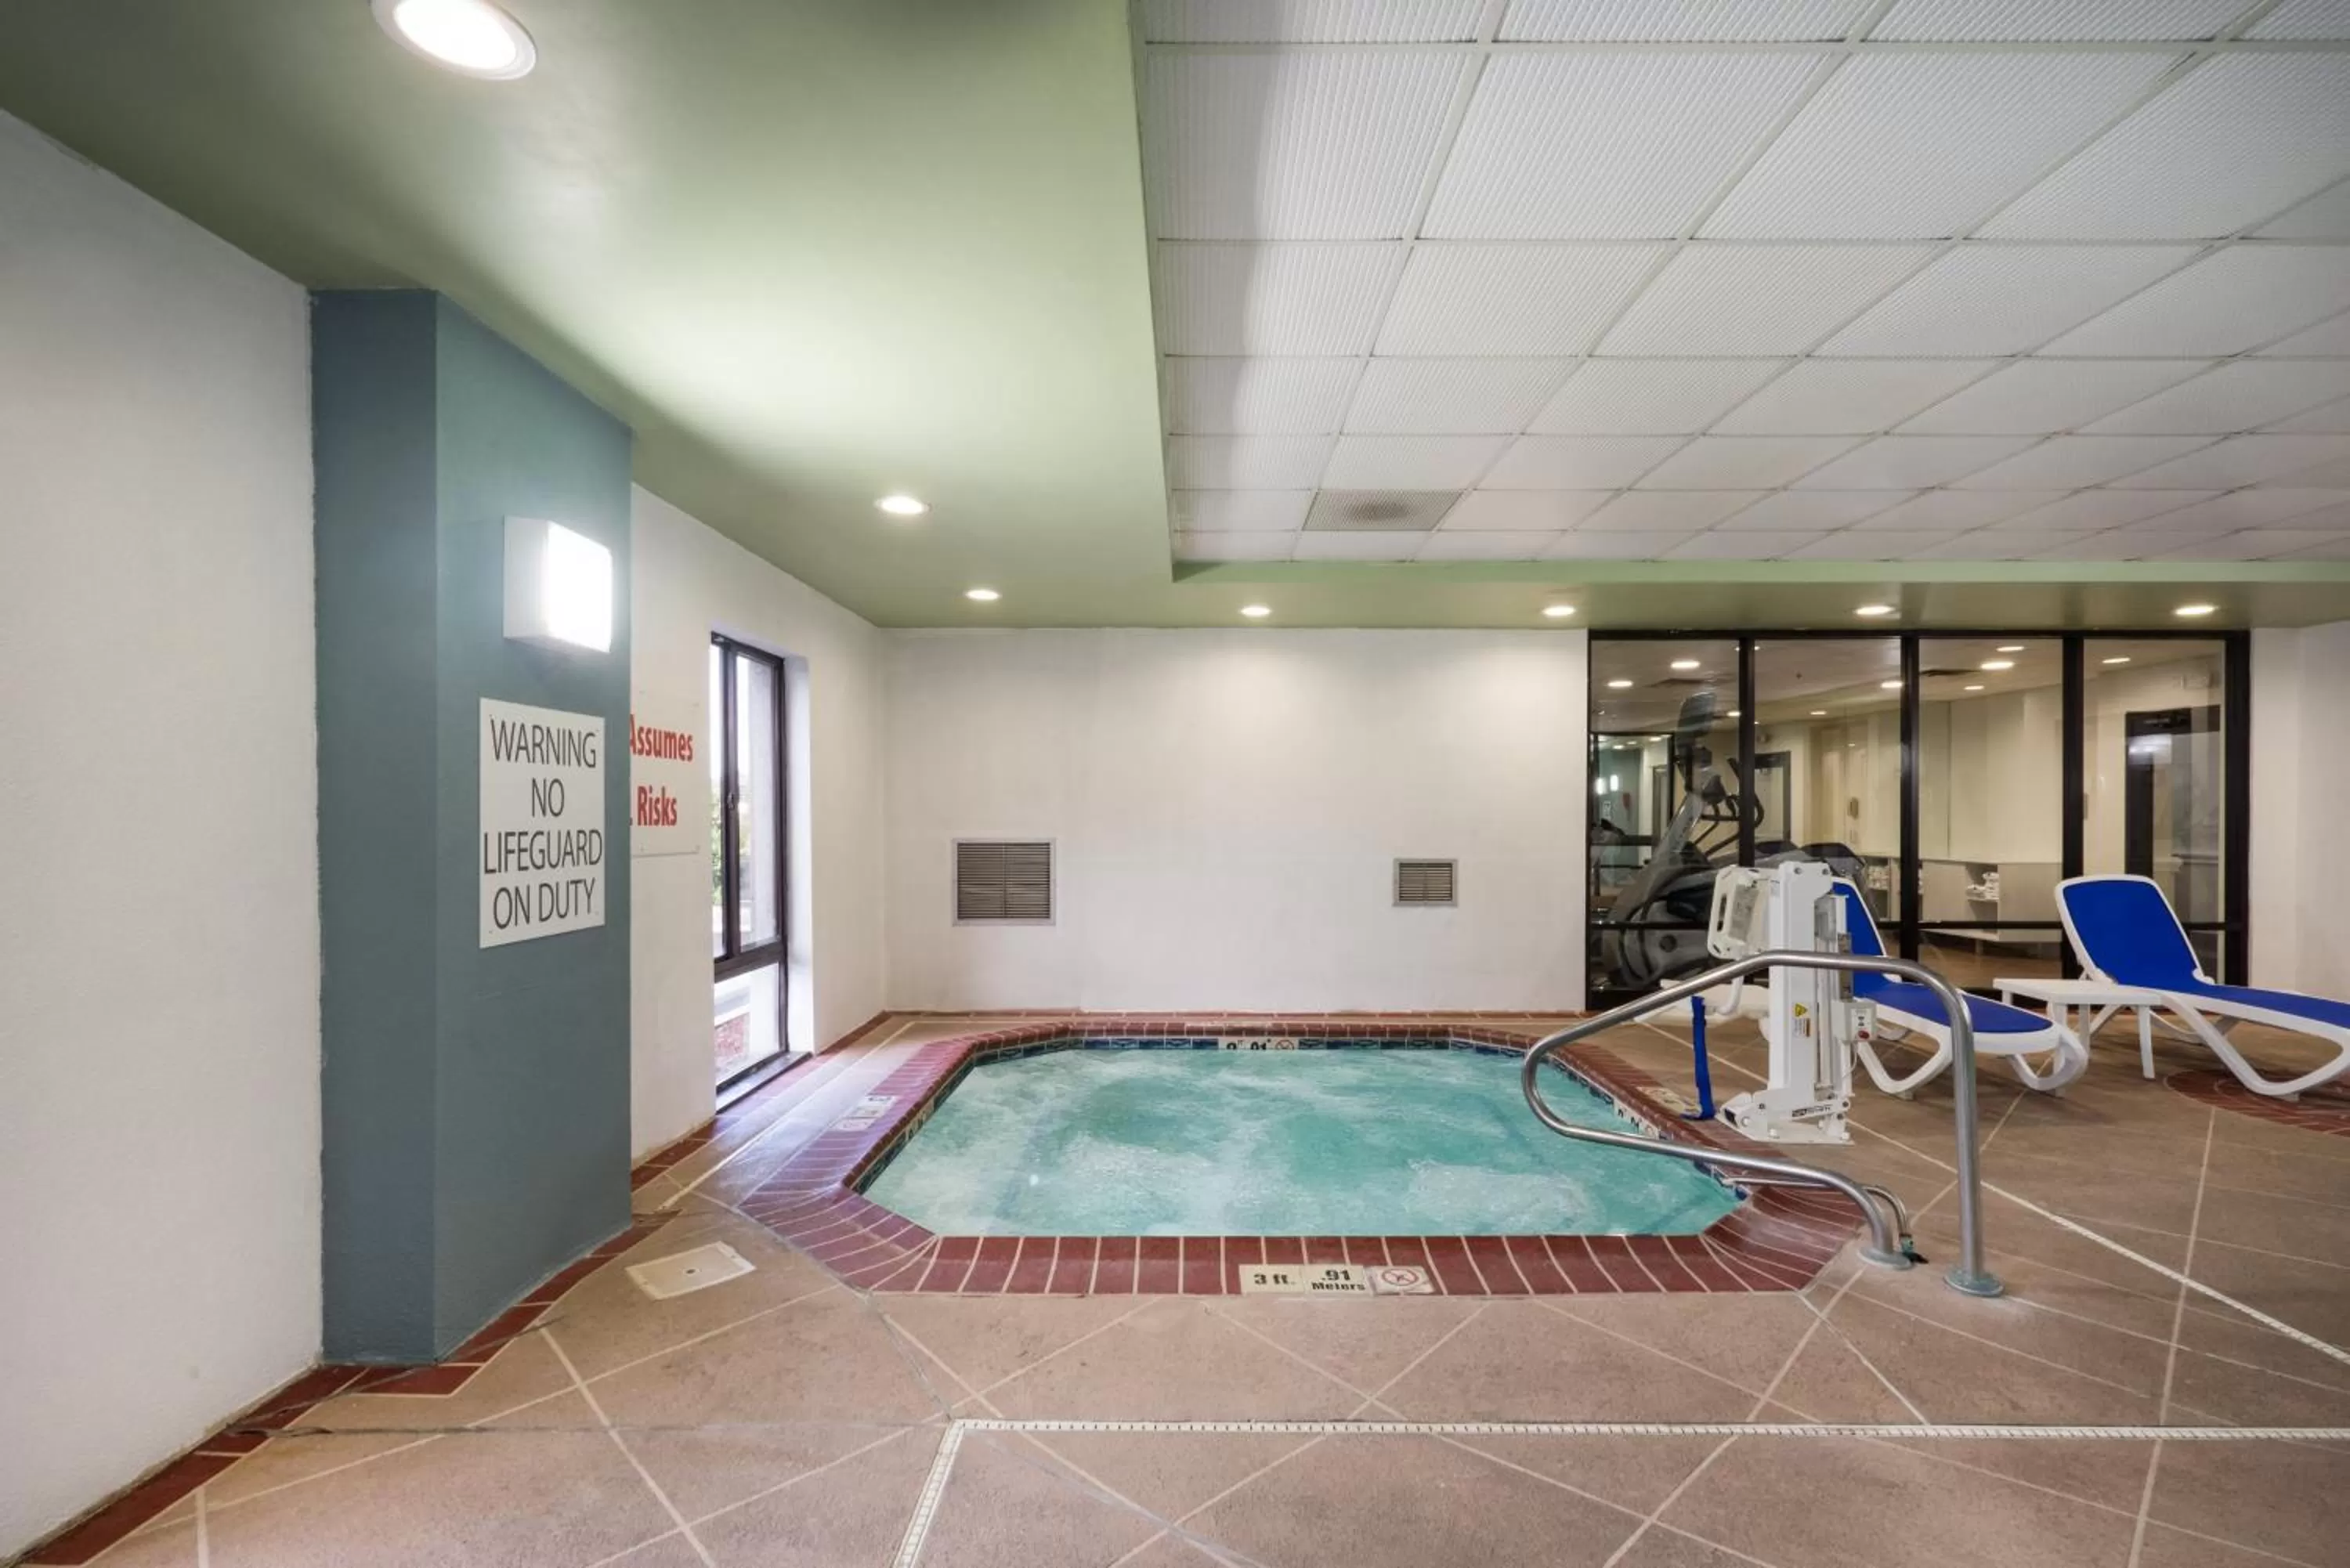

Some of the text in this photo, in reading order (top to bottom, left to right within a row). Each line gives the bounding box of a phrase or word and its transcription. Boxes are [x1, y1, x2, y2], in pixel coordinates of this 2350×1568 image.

[490, 718, 596, 768] WARNING
[531, 778, 565, 818] NO
[638, 785, 678, 826] Risks
[484, 828, 602, 874] LIFEGUARD
[493, 877, 595, 930] ON DUTY
[1253, 1274, 1267, 1285] 3
[1311, 1282, 1366, 1292] Meters
